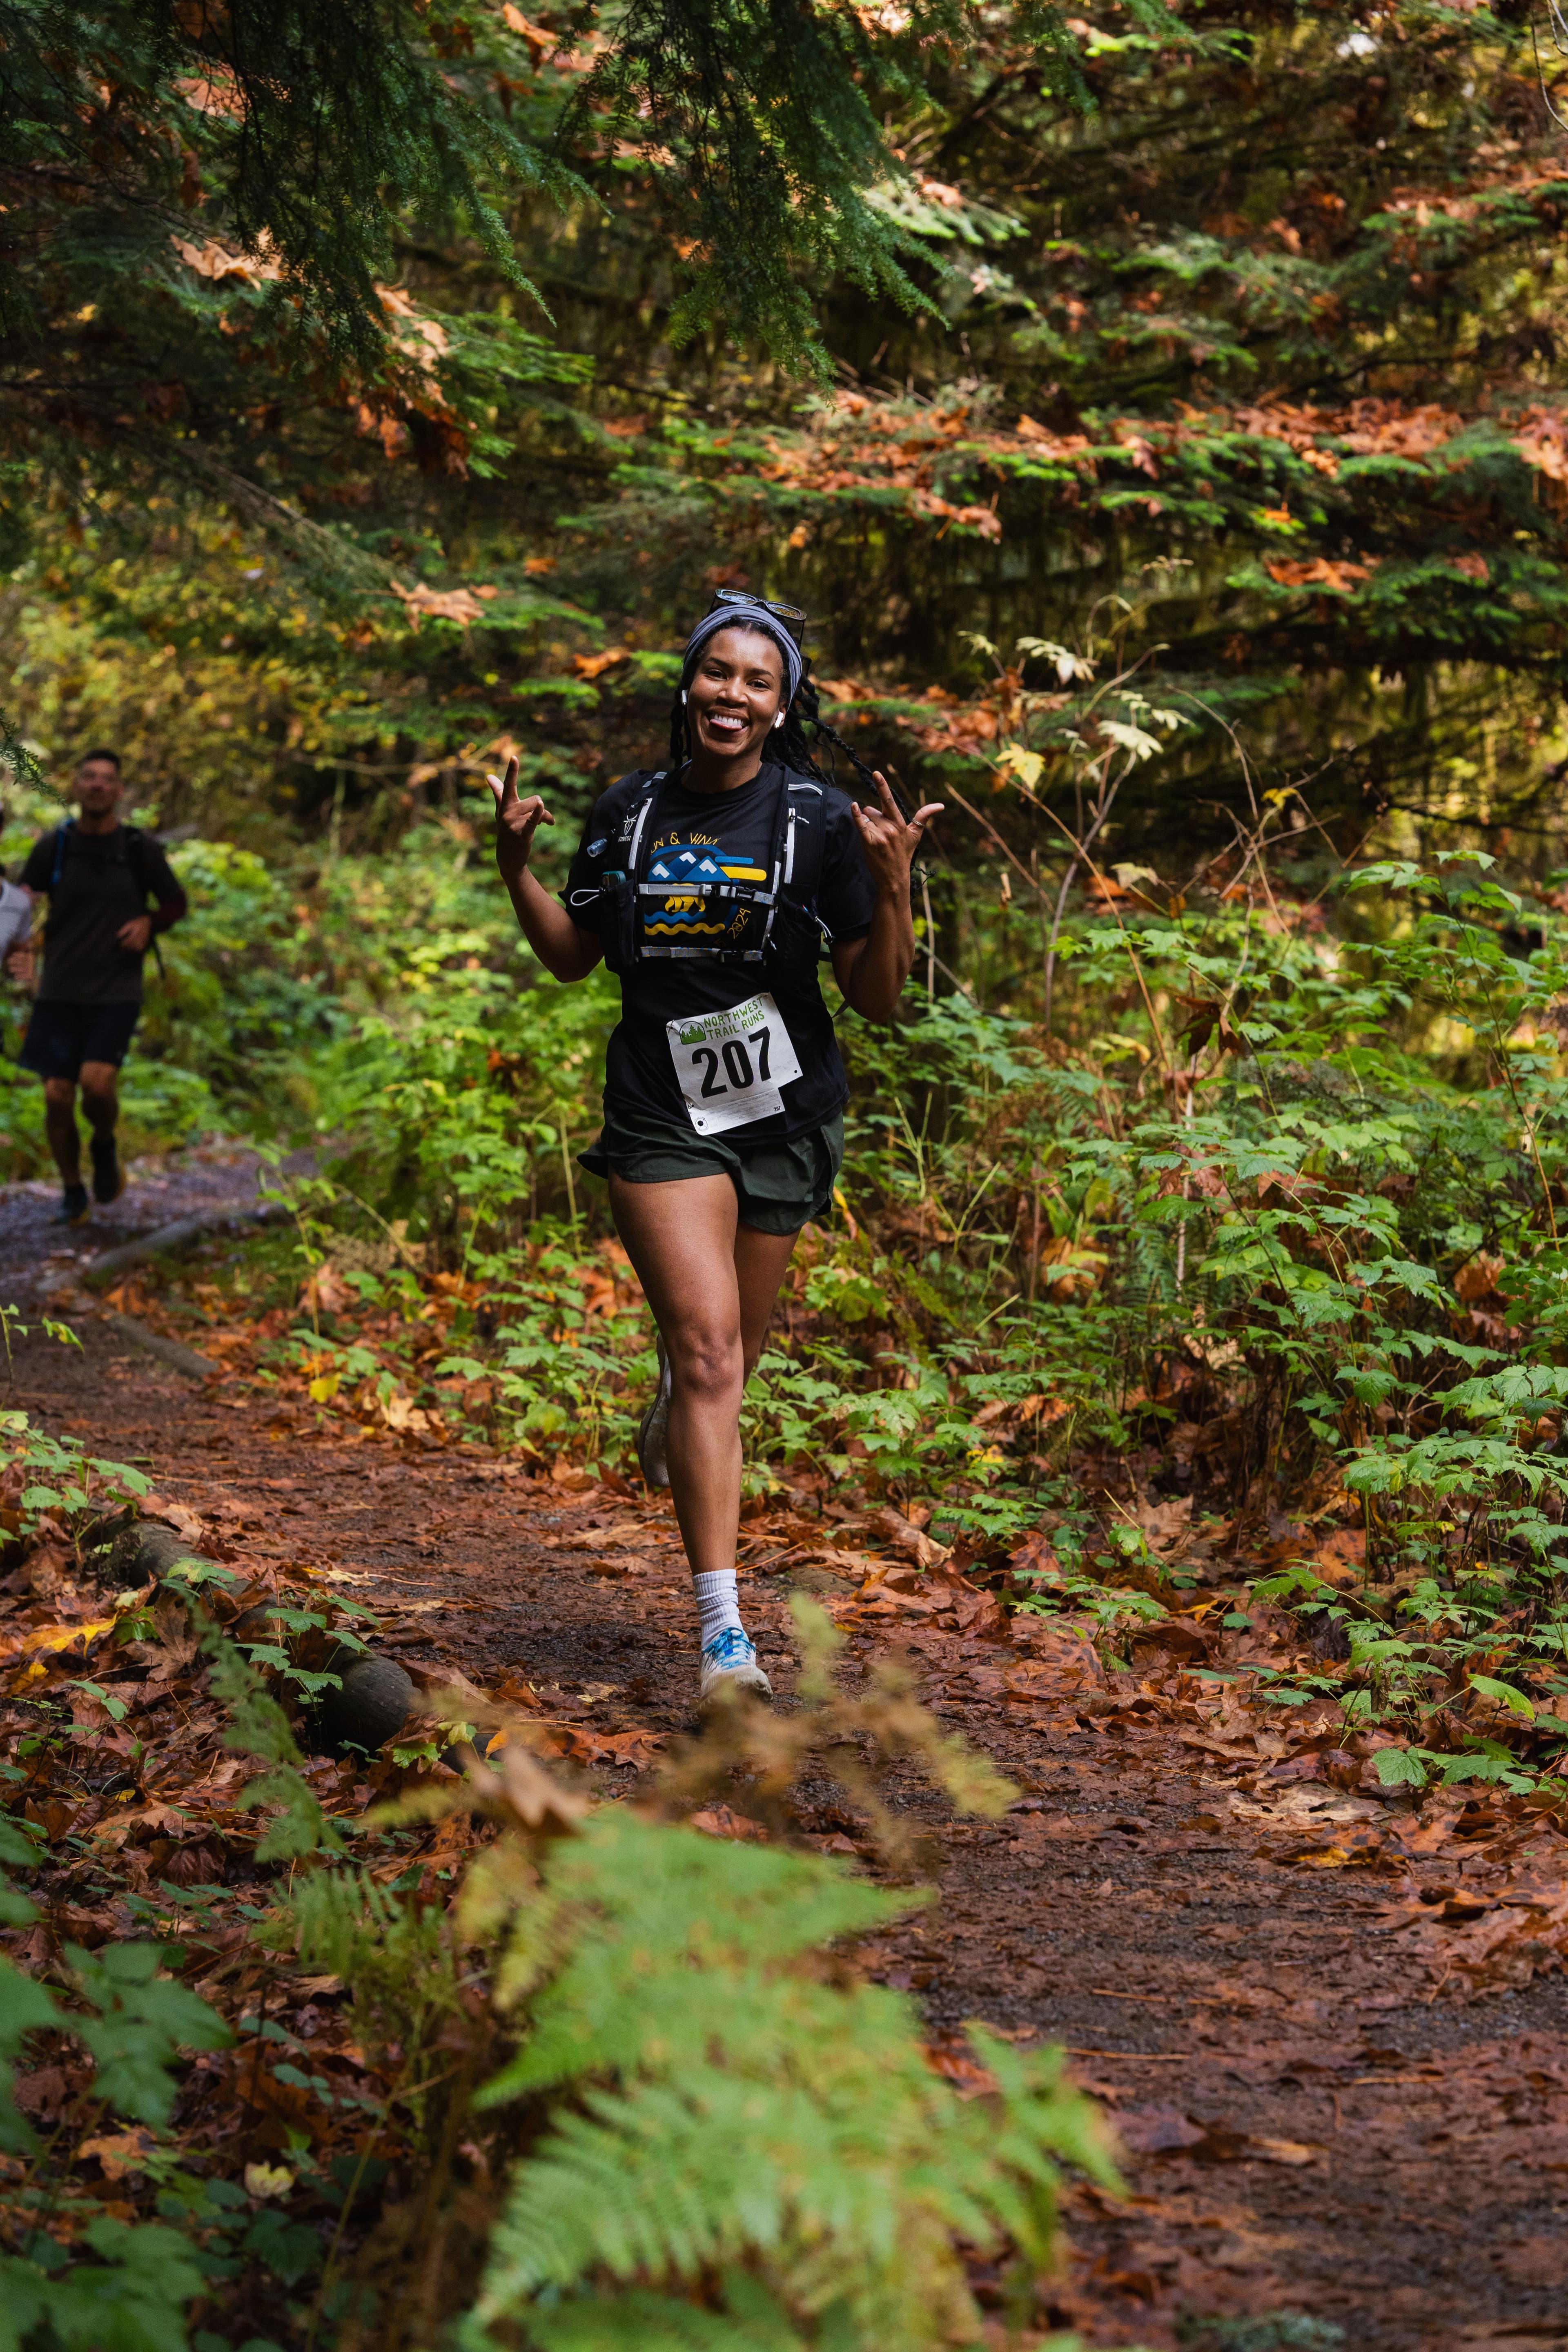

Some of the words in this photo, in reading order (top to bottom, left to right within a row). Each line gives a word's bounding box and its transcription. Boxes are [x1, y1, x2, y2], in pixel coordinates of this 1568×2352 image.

[650, 837, 664, 855] UN
[670, 832, 681, 844] &
[727, 908, 751, 939] 2024
[704, 996, 763, 1029] NORTHWEST
[706, 1024, 740, 1040] TRAIL
[741, 1010, 765, 1030] RUNS
[691, 1026, 771, 1098] 207
